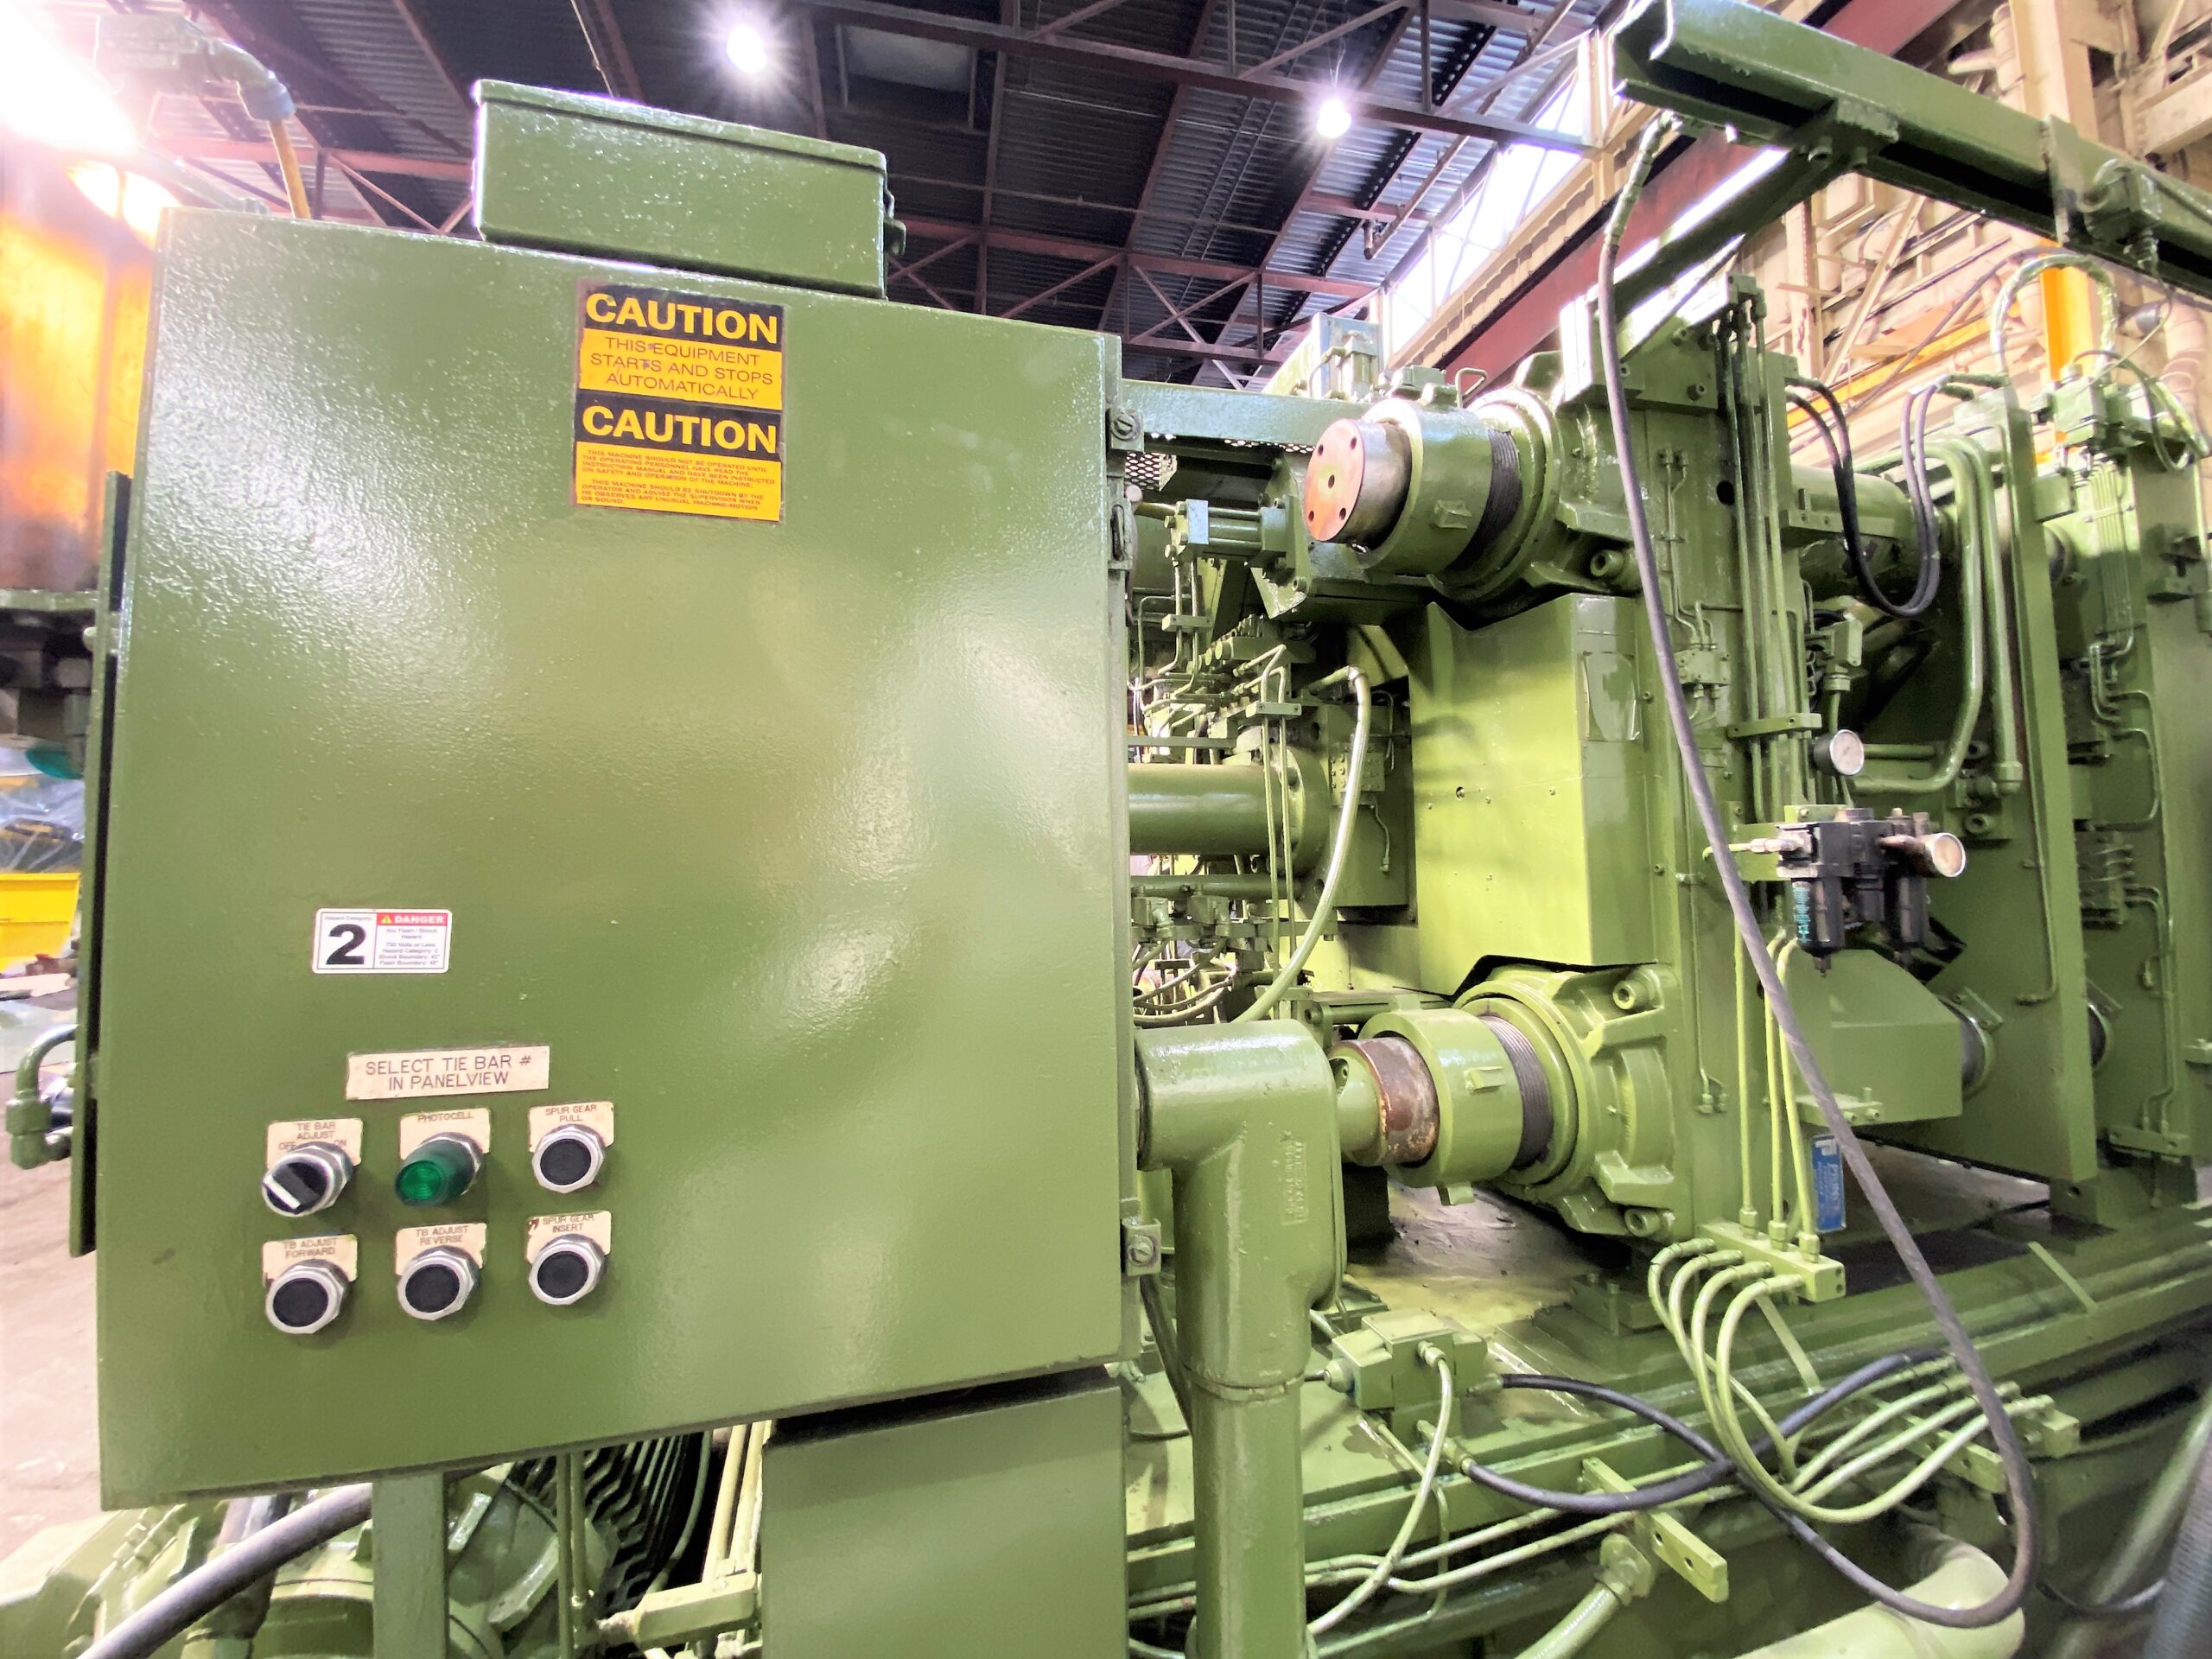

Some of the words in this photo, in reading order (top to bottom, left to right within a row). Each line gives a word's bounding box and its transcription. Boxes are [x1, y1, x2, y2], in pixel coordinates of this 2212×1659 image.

[586, 293, 777, 344] CAUTION
[605, 337, 645, 353] THIS
[653, 342, 760, 366] EQUIPMENT
[590, 353, 662, 372] STARTS
[669, 363, 708, 378] AND
[715, 368, 772, 385] STOPS
[606, 373, 759, 400] AUTOMATICALLY
[582, 405, 776, 454] CAUTION
[326, 924, 366, 964] 2
[365, 1058, 434, 1075] SELECT
[442, 1057, 467, 1071] TIE
[475, 1055, 512, 1070] BAR
[519, 1055, 531, 1066] #
[389, 1077, 403, 1090] IN
[410, 1071, 509, 1090] PANELVIEW
[545, 1107, 569, 1116] SPUR
[573, 1104, 597, 1113] GEAR
[417, 1111, 474, 1122] PHOTOCELL
[315, 1122, 335, 1130] BAR
[297, 1131, 334, 1140] ADJUST
[543, 1216, 566, 1224] SPUR
[570, 1214, 594, 1223] GEAR
[432, 1225, 468, 1236] ADJUST
[553, 1223, 583, 1233] INSERT
[283, 1241, 296, 1249] TB
[301, 1238, 338, 1248] ADJUST
[420, 1235, 463, 1245] REVERSE
[286, 1247, 335, 1258] FORWARD
